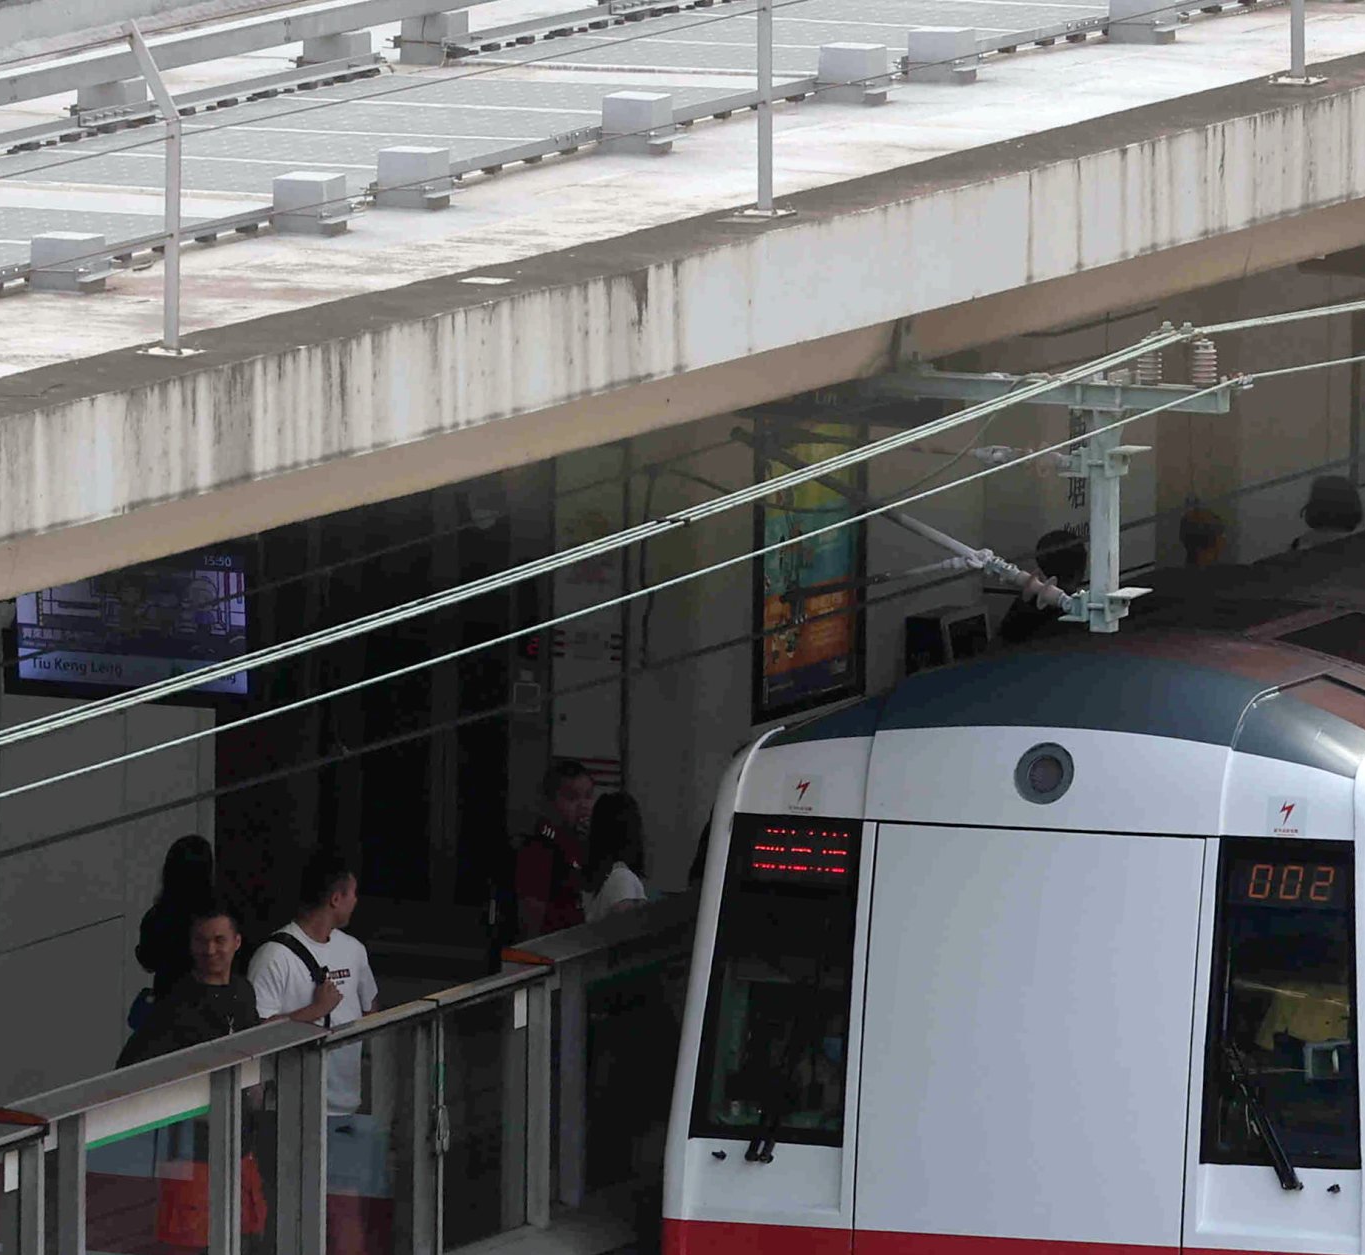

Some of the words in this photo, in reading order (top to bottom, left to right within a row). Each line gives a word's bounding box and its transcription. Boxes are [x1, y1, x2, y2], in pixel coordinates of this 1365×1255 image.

[32, 656, 51, 670] Tiu
[54, 658, 86, 676] Keng
[91, 662, 123, 678] Leng
[1248, 864, 1335, 901] 002
